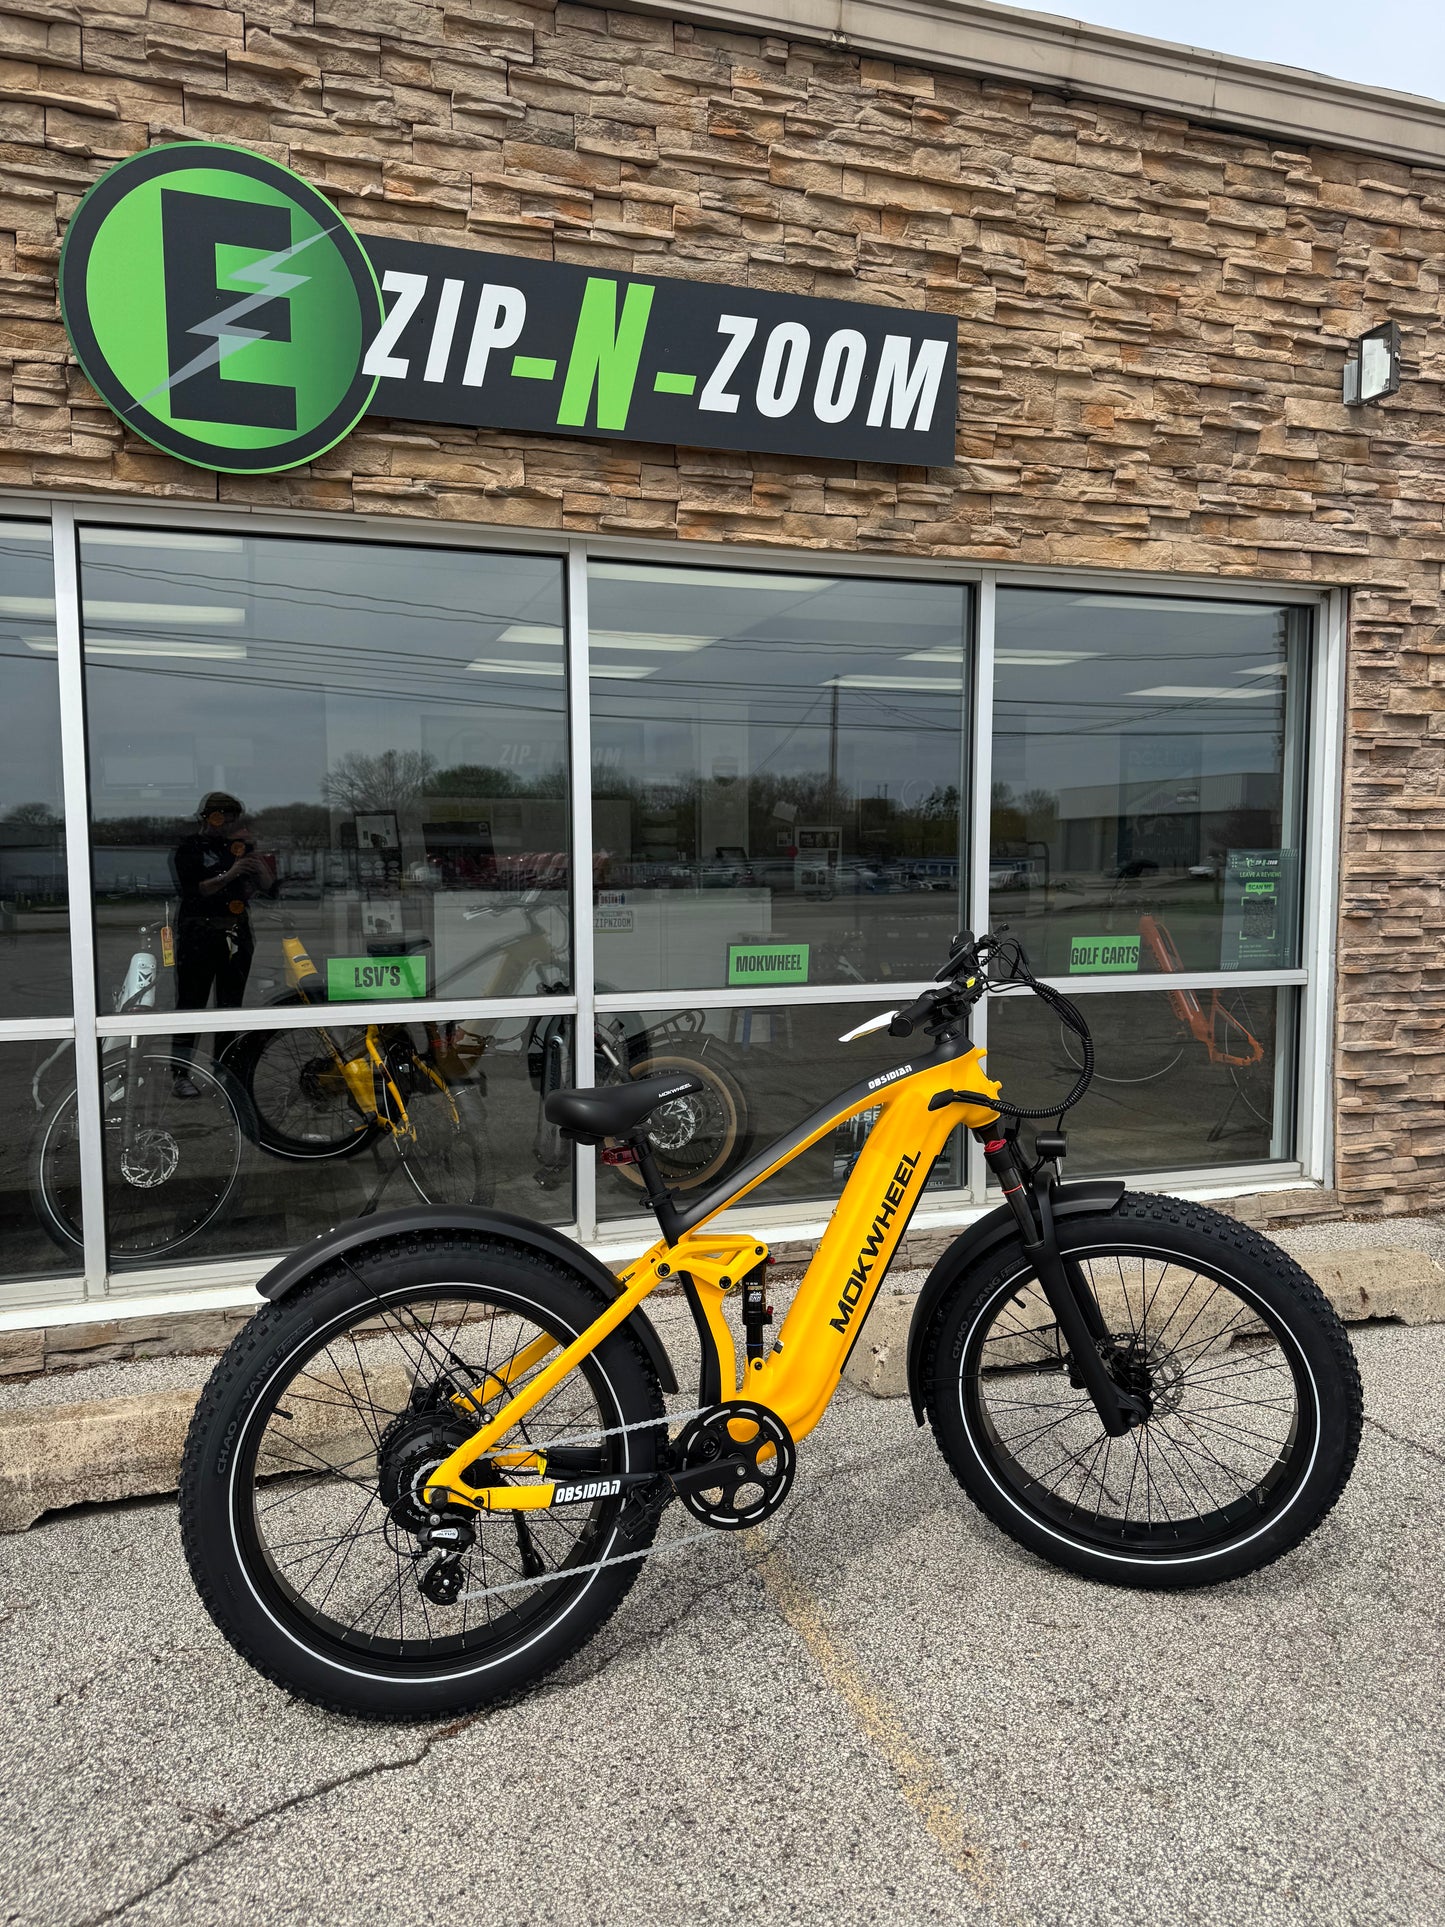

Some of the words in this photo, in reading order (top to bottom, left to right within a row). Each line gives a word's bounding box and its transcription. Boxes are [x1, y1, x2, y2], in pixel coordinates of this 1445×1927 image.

[160, 187, 299, 432] E
[362, 270, 951, 432] ZIP-N-ZOOM
[735, 954, 802, 973] MOKWHEEL
[1071, 947, 1099, 966] GOLF
[1101, 946, 1139, 965] CARTS
[354, 965, 401, 988] LSV'S
[658, 1082, 693, 1099] MOKWHEEL
[828, 1151, 922, 1335] MOKWHEEL
[555, 1479, 621, 1504] OBSIDIAN
